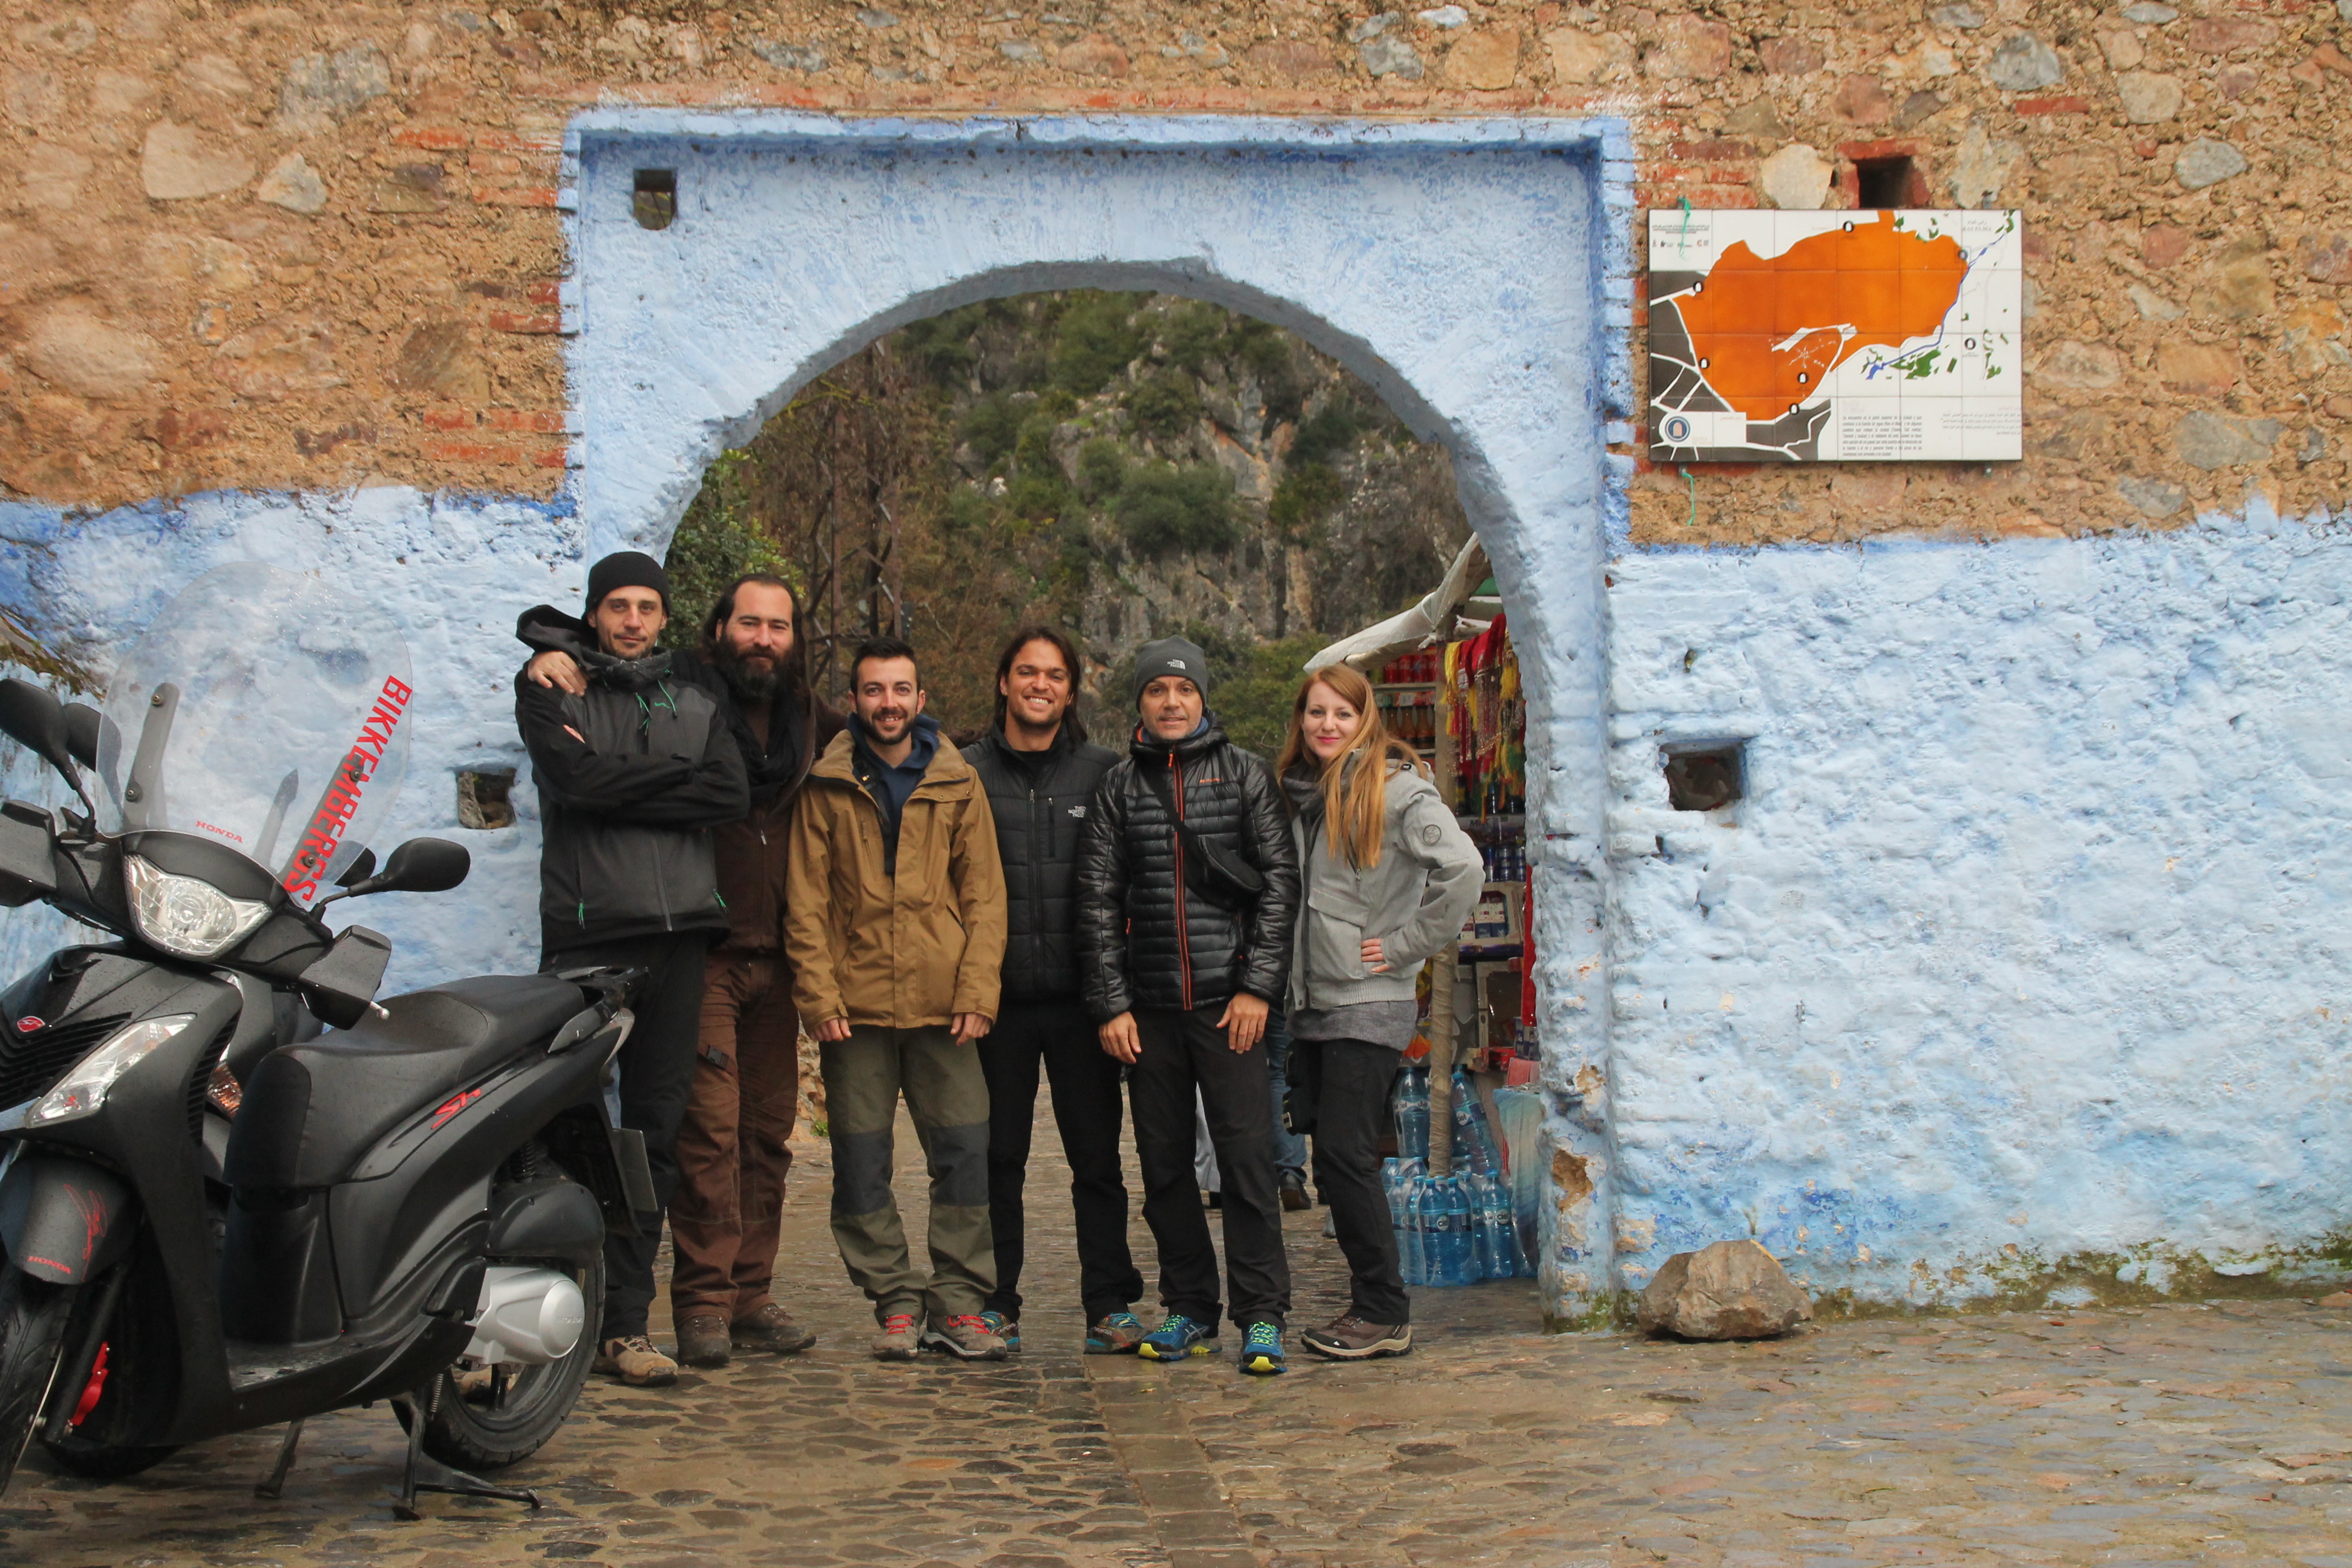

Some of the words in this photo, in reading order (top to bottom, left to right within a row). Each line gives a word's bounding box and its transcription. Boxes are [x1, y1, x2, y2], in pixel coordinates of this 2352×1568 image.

[283, 675, 412, 901] BIKKEMBERGS
[195, 820, 243, 843] HONDA
[28, 1256, 71, 1274] HONDA
